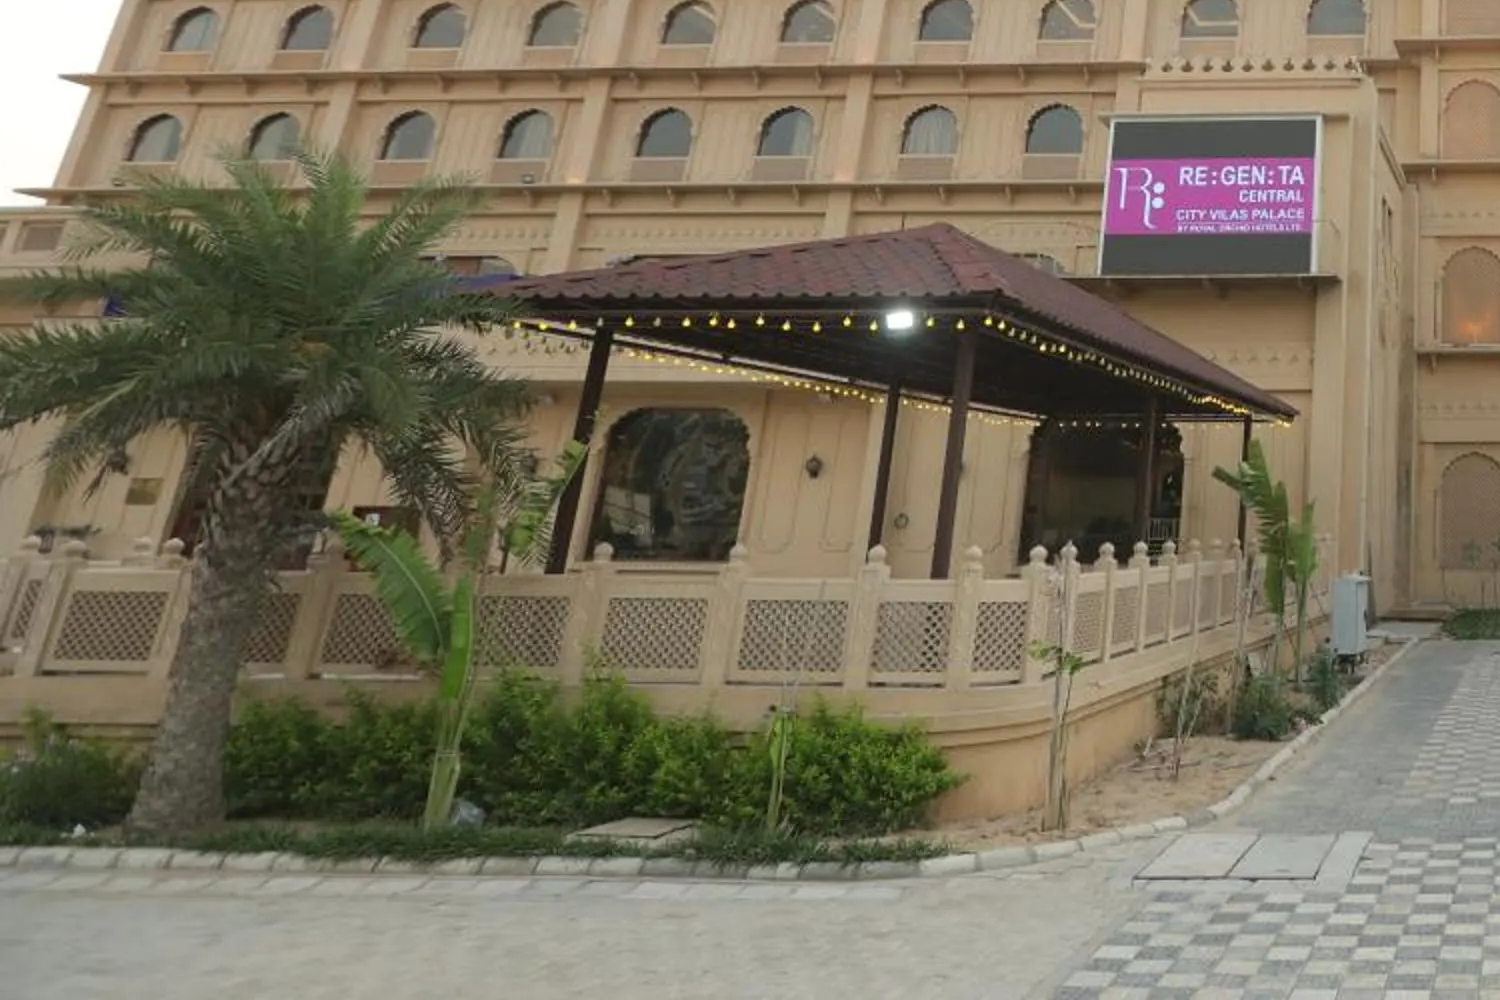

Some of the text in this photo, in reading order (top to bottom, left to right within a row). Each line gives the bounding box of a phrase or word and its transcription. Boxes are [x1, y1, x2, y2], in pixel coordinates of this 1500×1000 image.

[1239, 189, 1304, 203] CENTRAL
[1176, 207, 1305, 221] CITY VILAS PALACE
